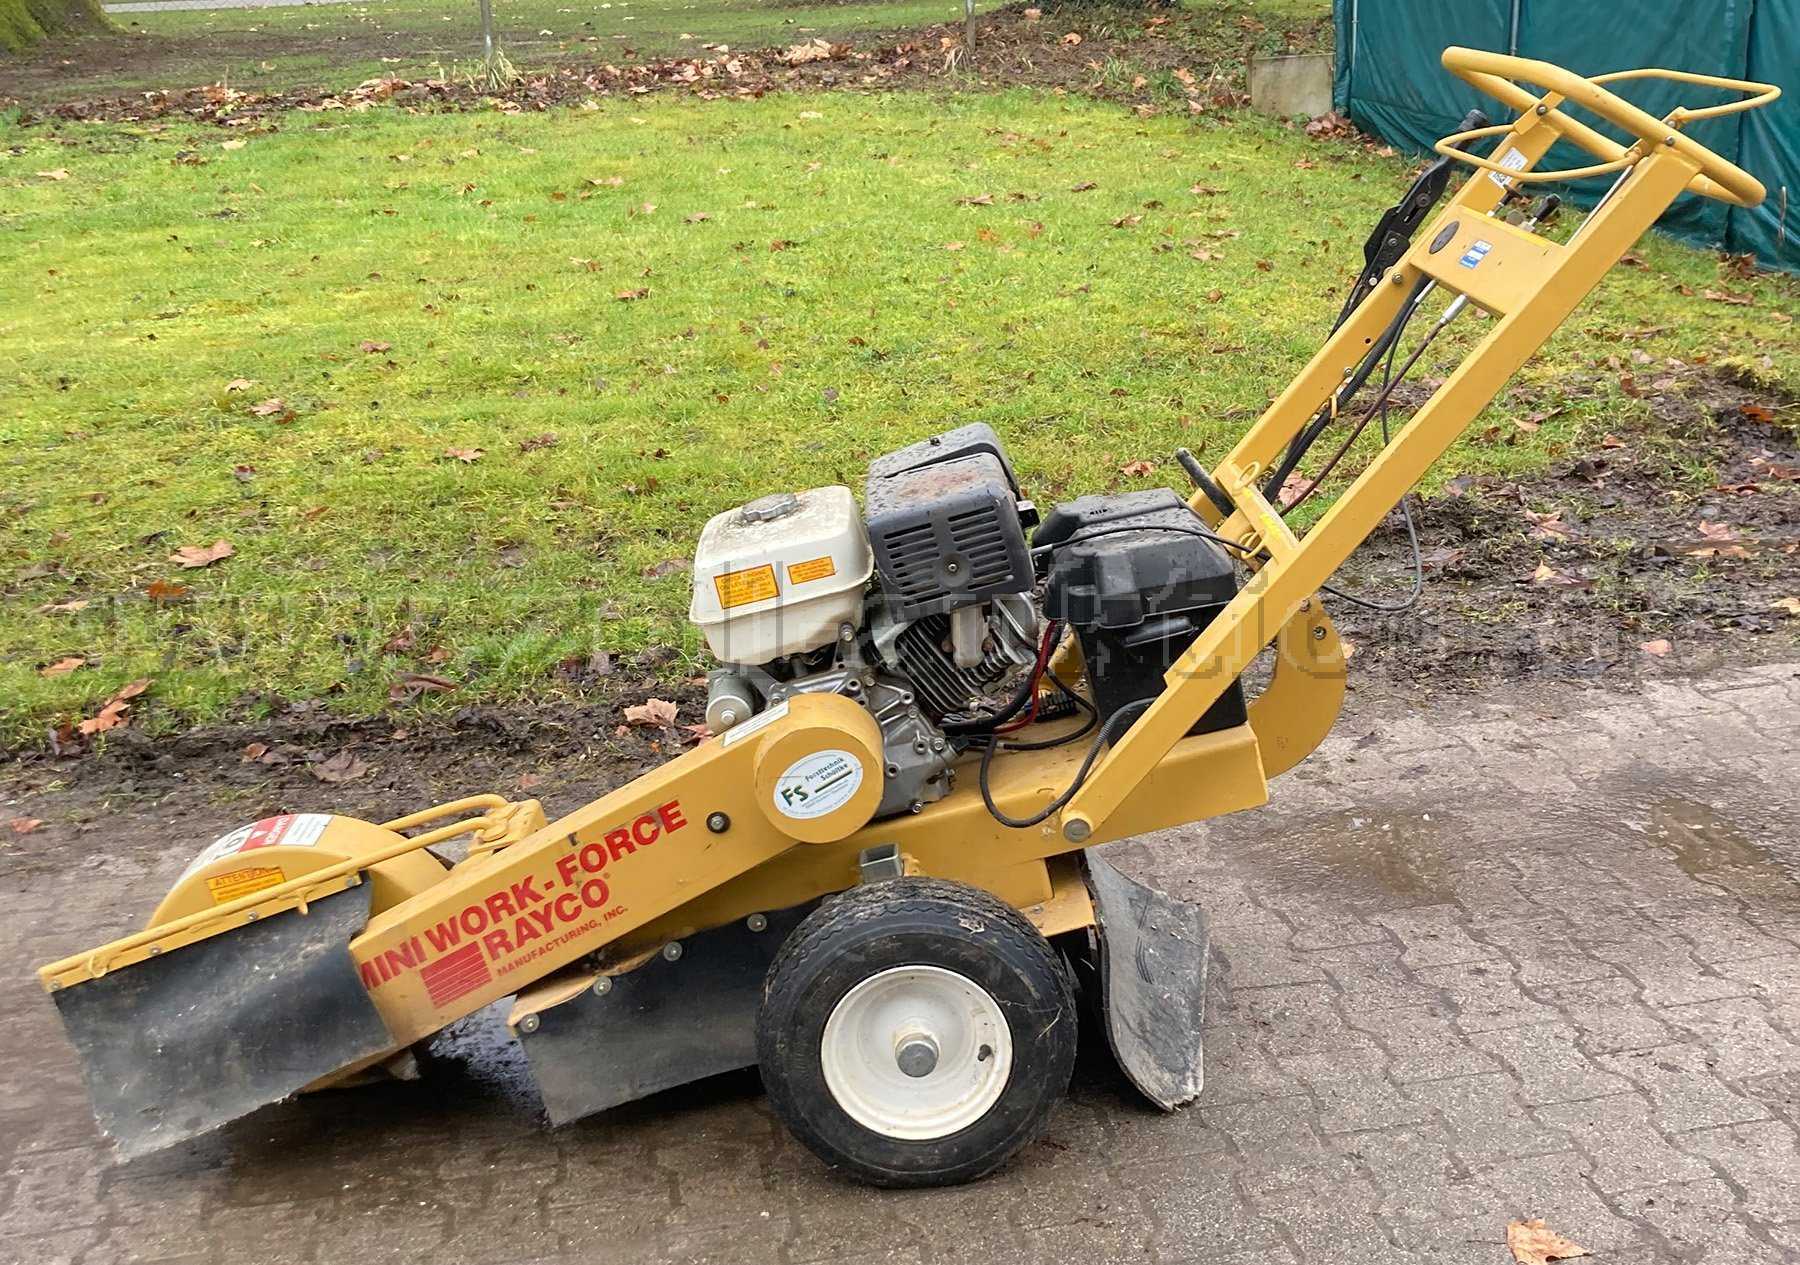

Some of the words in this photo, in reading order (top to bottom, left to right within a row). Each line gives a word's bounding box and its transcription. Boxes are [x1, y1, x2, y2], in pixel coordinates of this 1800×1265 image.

[781, 785, 809, 806] FS
[482, 878, 610, 961] RAYCO
[603, 904, 629, 922] INC.
